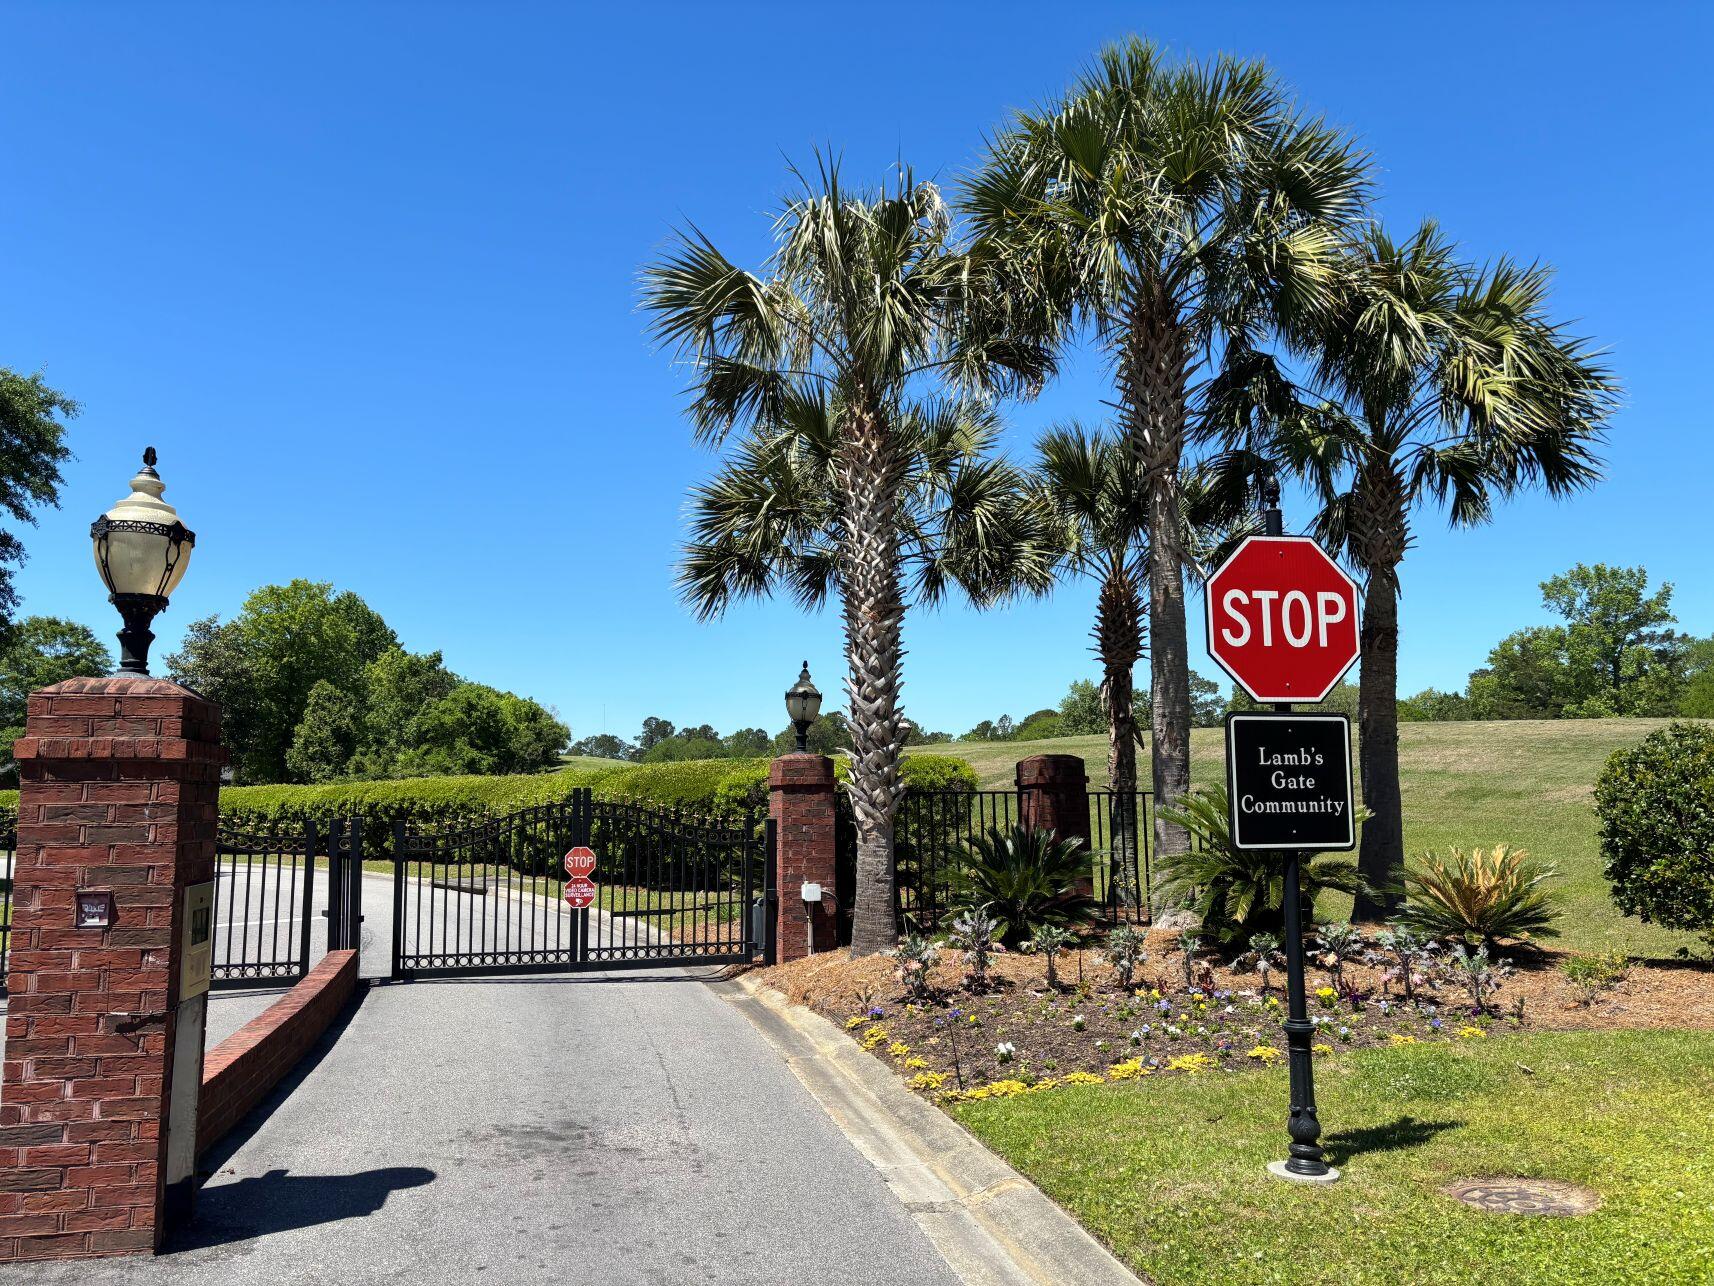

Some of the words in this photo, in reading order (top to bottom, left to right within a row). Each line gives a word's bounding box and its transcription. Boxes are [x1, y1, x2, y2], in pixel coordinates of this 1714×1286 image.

[1222, 589, 1346, 647] STOP
[1259, 747, 1324, 766] Lamb's
[1271, 770, 1315, 789] Gate
[1241, 795, 1345, 815] Community
[566, 856, 594, 868] STOP
